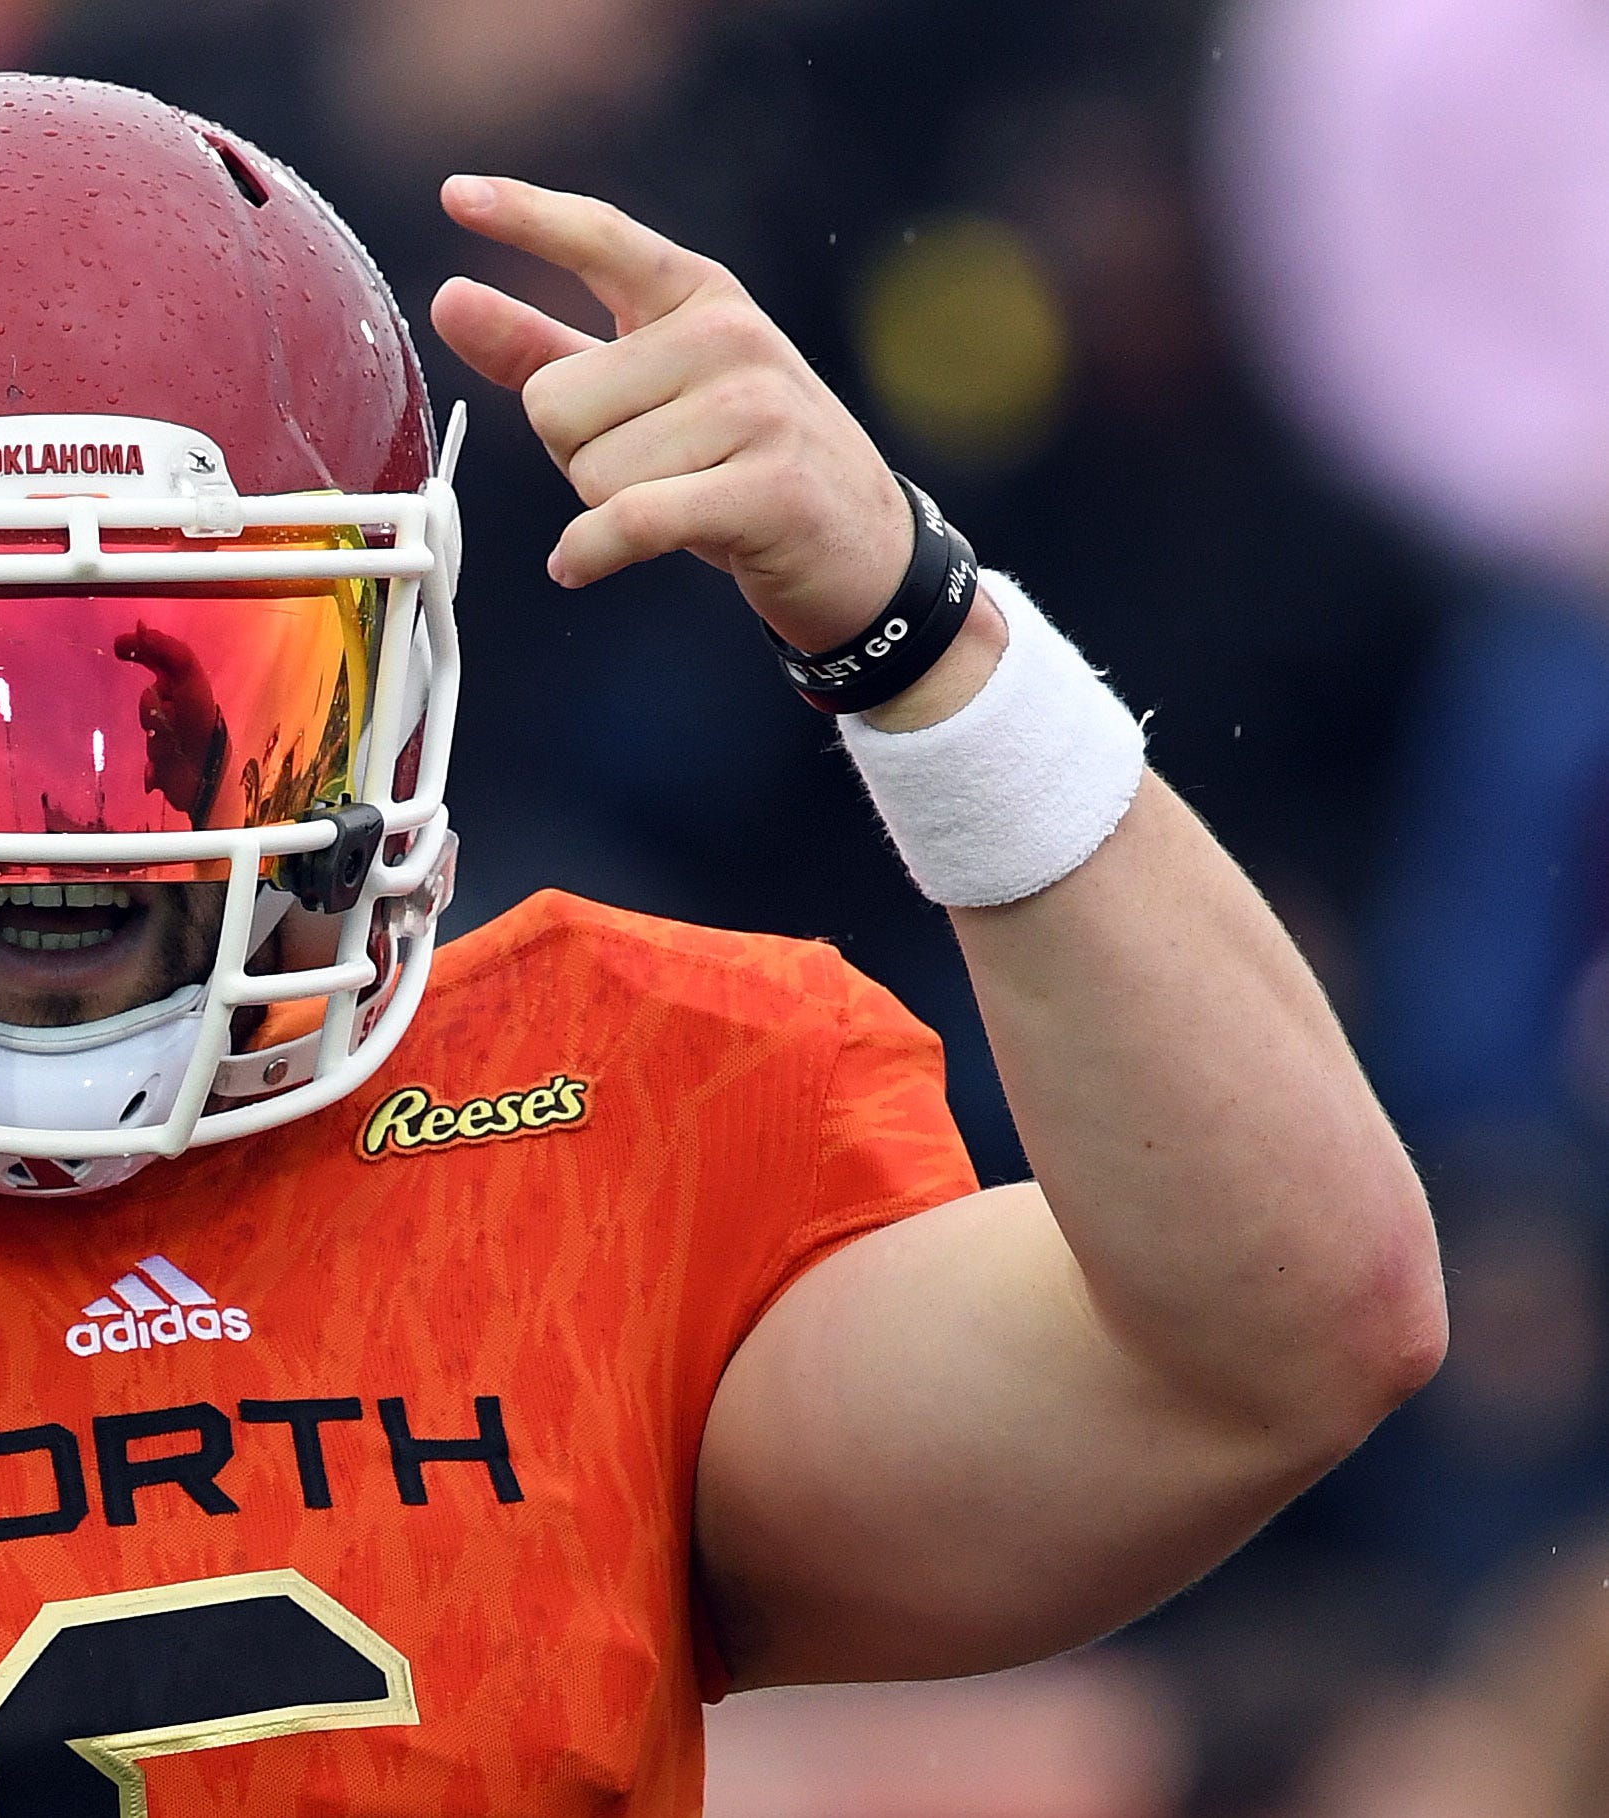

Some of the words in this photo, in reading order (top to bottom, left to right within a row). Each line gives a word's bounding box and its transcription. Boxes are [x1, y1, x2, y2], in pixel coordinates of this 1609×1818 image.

[808, 654, 862, 680] LET
[865, 617, 908, 658] GO
[364, 1076, 586, 1154] Reese's
[65, 1305, 252, 1357] adidas
